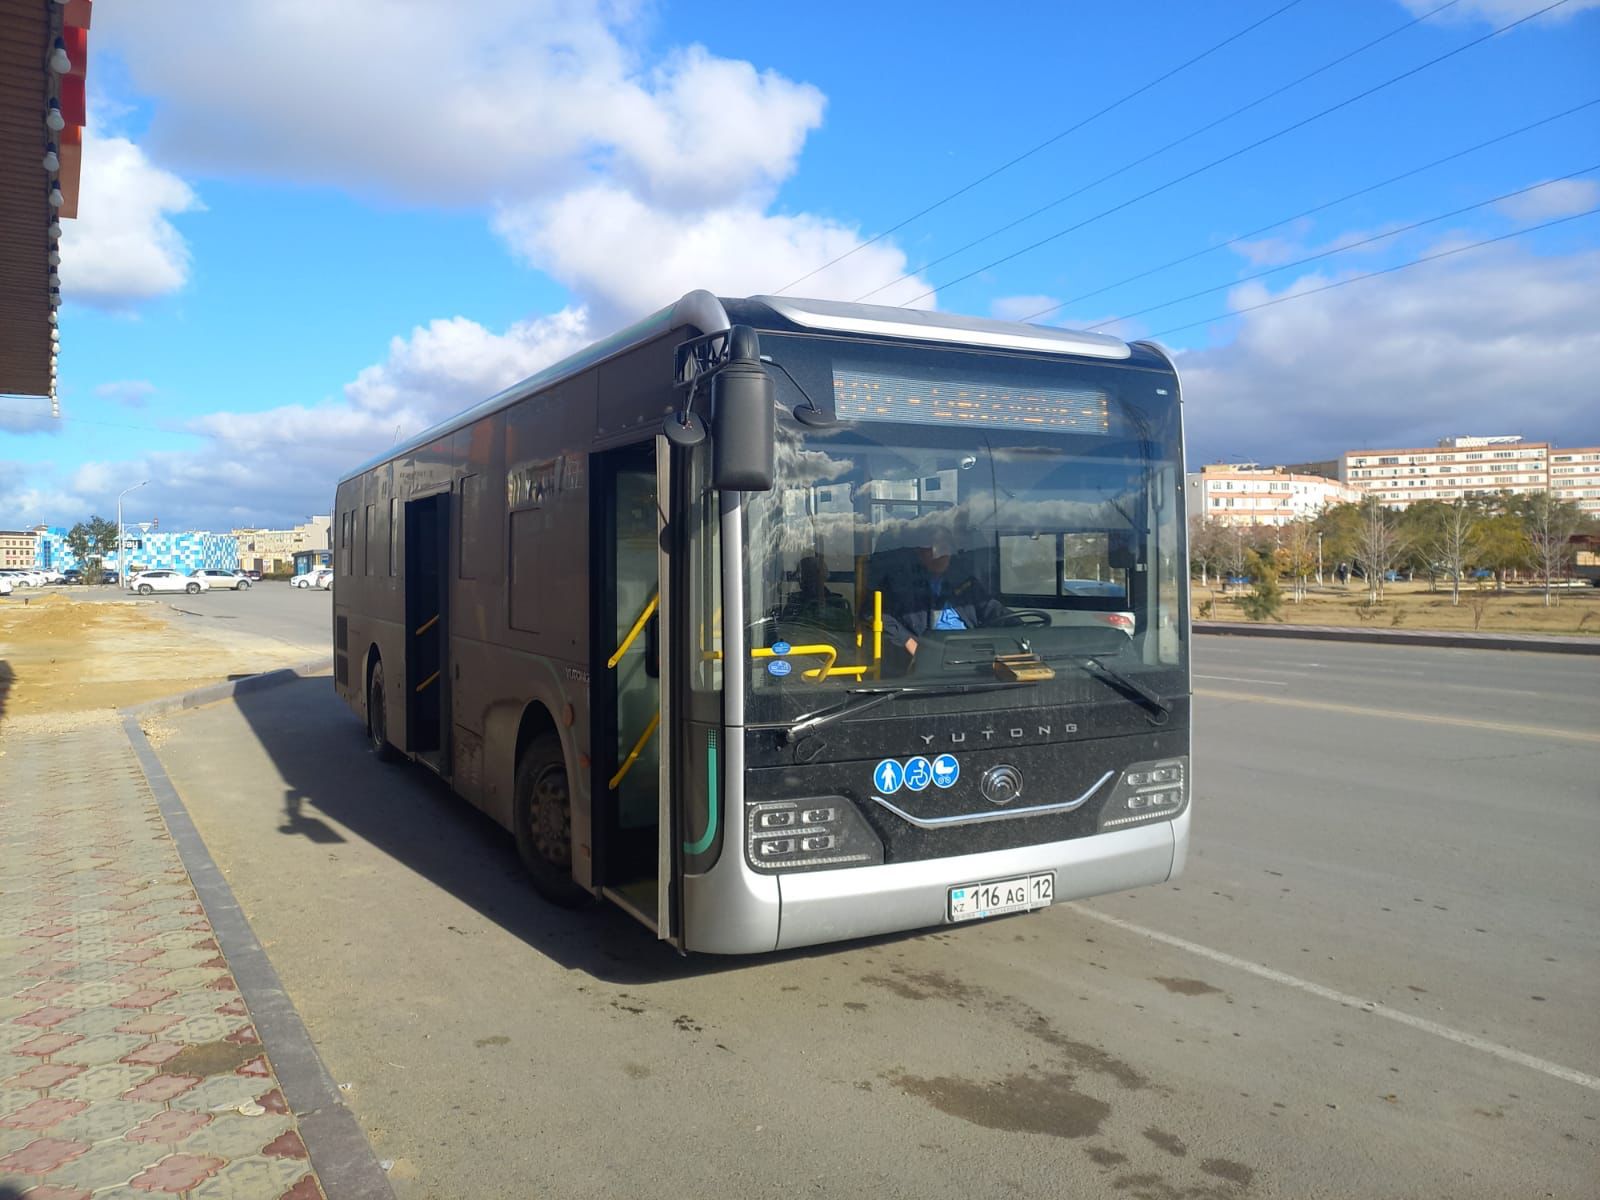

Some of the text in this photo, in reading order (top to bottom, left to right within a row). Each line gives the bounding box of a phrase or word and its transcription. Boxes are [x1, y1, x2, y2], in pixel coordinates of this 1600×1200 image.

[921, 723, 1078, 745] YUTONG
[971, 886, 1000, 910] 116
[1005, 887, 1025, 905] AG
[1033, 878, 1051, 900] 12
[953, 903, 965, 913] KZ
